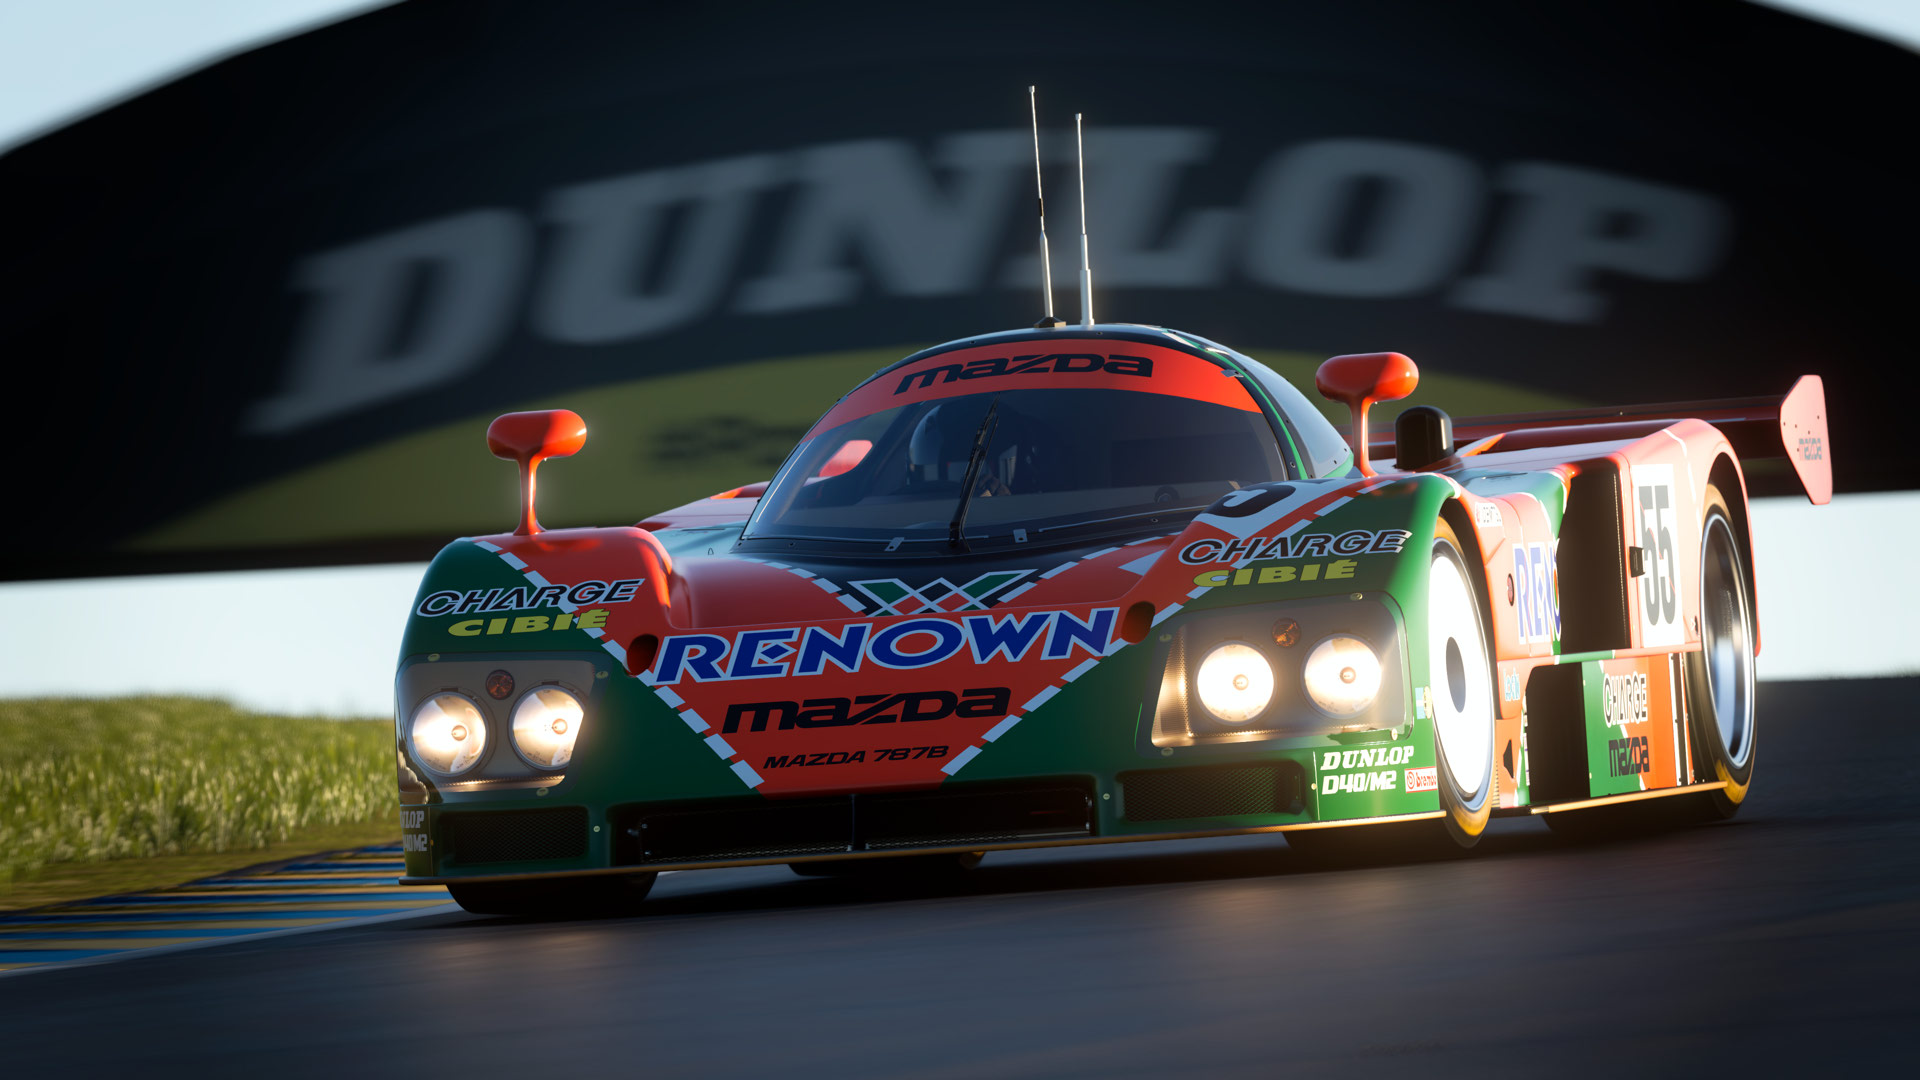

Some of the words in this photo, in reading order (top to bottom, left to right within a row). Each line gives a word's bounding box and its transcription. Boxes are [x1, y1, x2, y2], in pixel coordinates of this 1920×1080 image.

[245, 125, 1732, 436] DUNLOP
[1178, 529, 1413, 565] CHARGE
[1638, 485, 1676, 625] 55
[416, 578, 646, 617] CHARGE
[651, 606, 1120, 685] RENOWN
[1603, 671, 1648, 728] CHARGE
[763, 749, 867, 770] MAZDA
[873, 745, 949, 763] 787B
[1320, 745, 1415, 771] DUNLOP
[1321, 769, 1397, 796] D40/M2
